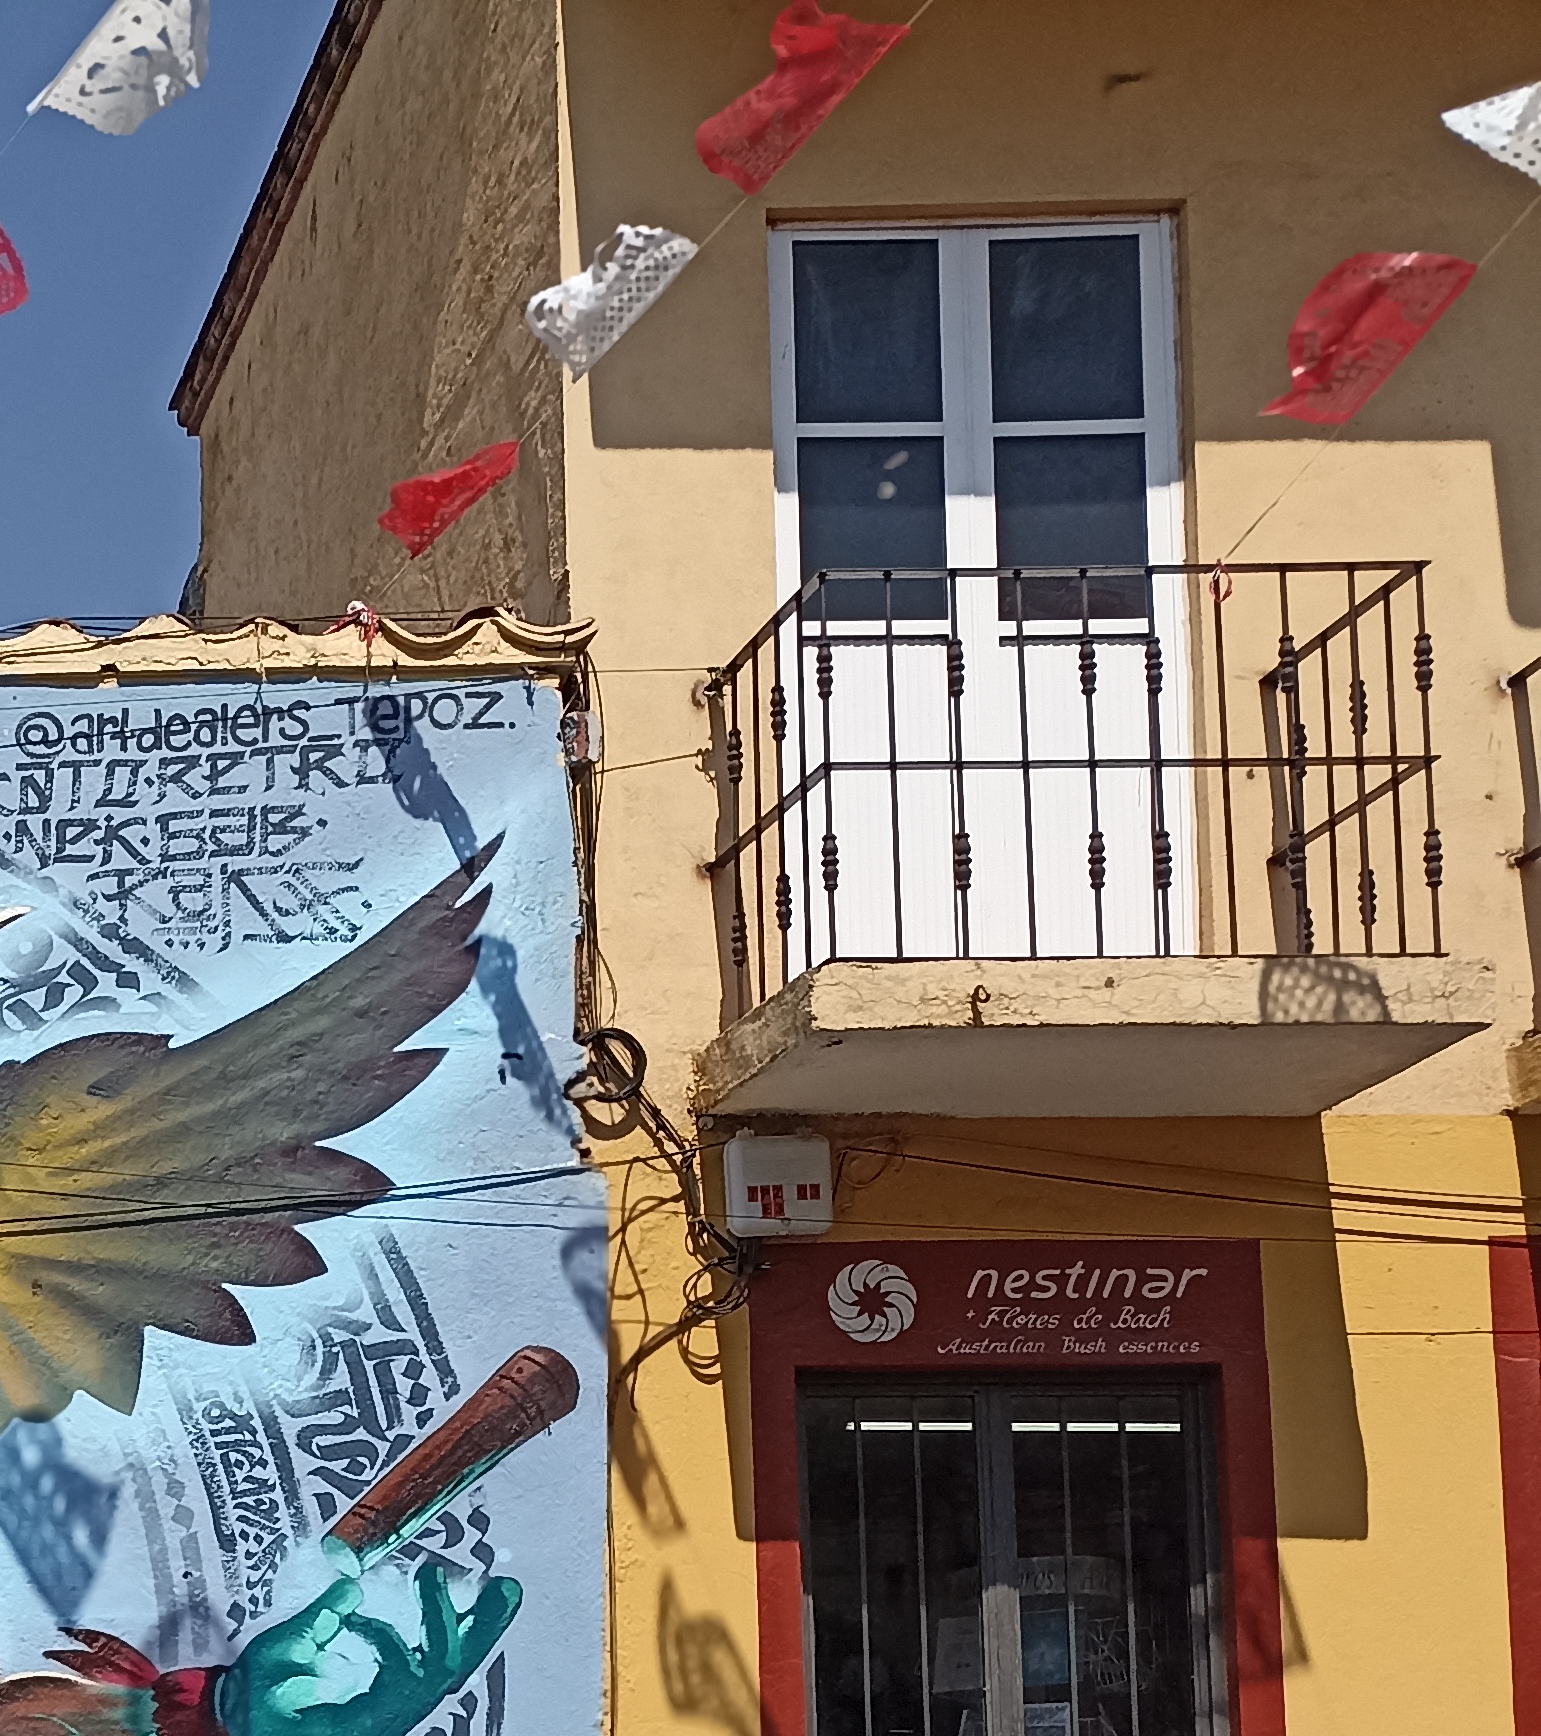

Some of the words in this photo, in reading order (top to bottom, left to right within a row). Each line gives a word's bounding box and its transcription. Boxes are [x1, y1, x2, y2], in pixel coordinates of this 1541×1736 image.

[967, 1261, 1209, 1299] nestinar
[979, 1306, 1061, 1330] Flores
[1073, 1306, 1103, 1330] de
[1110, 1305, 1172, 1330] Bach
[937, 1335, 1045, 1354] Australian
[1062, 1335, 1107, 1354] Bush
[1118, 1340, 1201, 1354] essences
